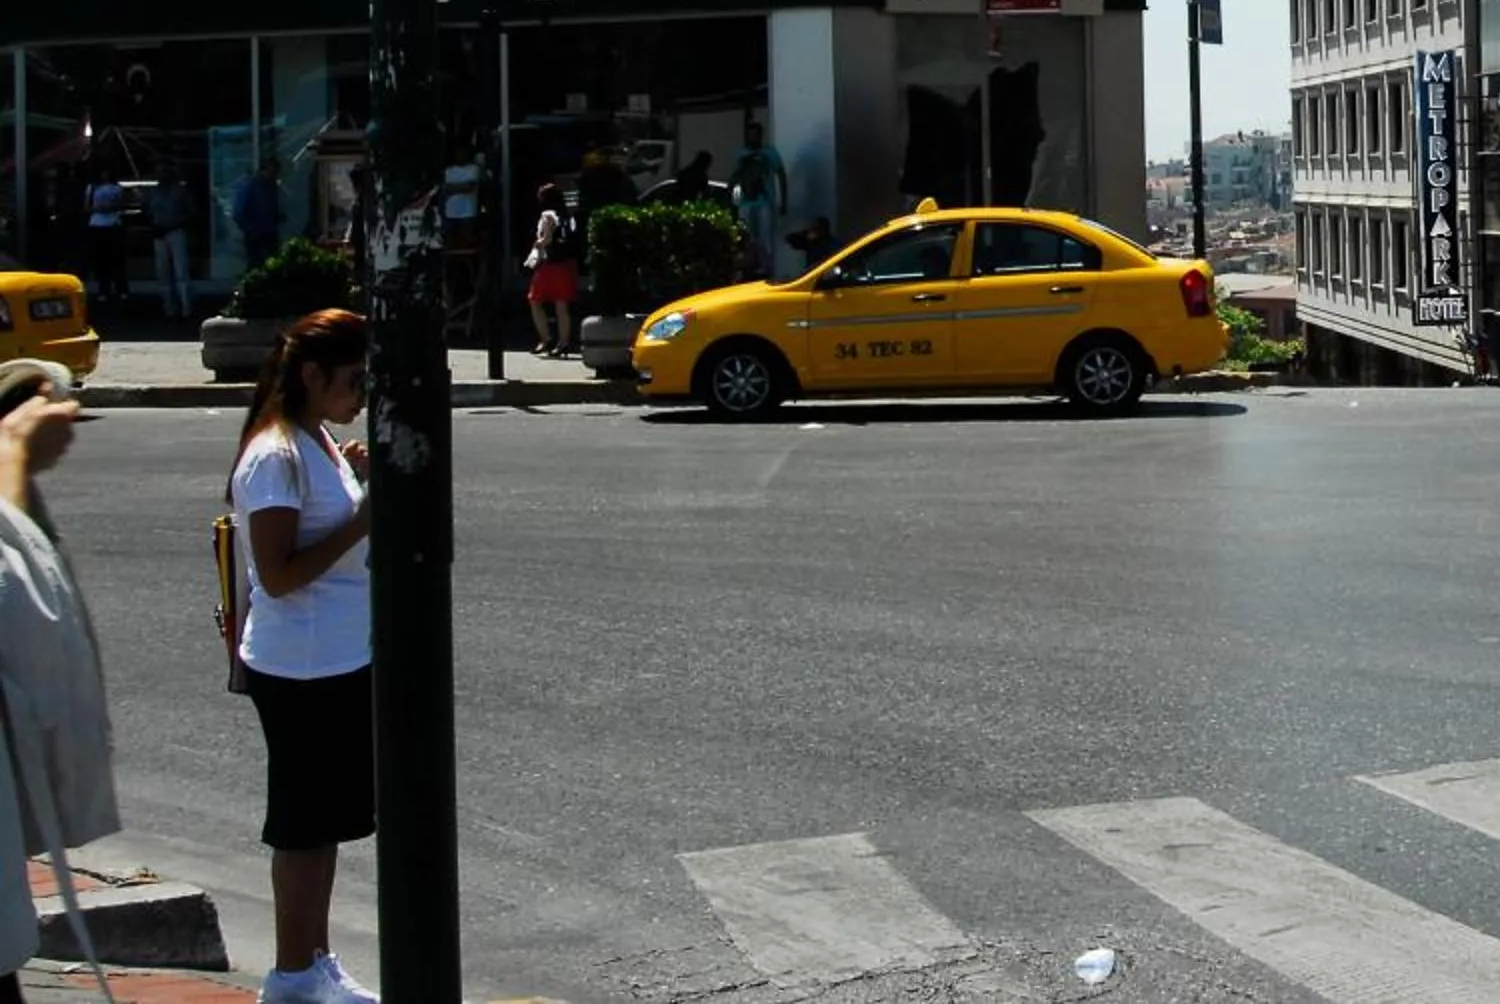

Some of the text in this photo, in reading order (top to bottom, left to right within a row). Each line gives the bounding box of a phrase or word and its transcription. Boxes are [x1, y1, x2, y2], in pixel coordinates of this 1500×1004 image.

[1422, 52, 1453, 286] METROPARK
[1419, 297, 1466, 321] HOTEL
[834, 341, 859, 360] 34
[867, 340, 904, 357] TEC
